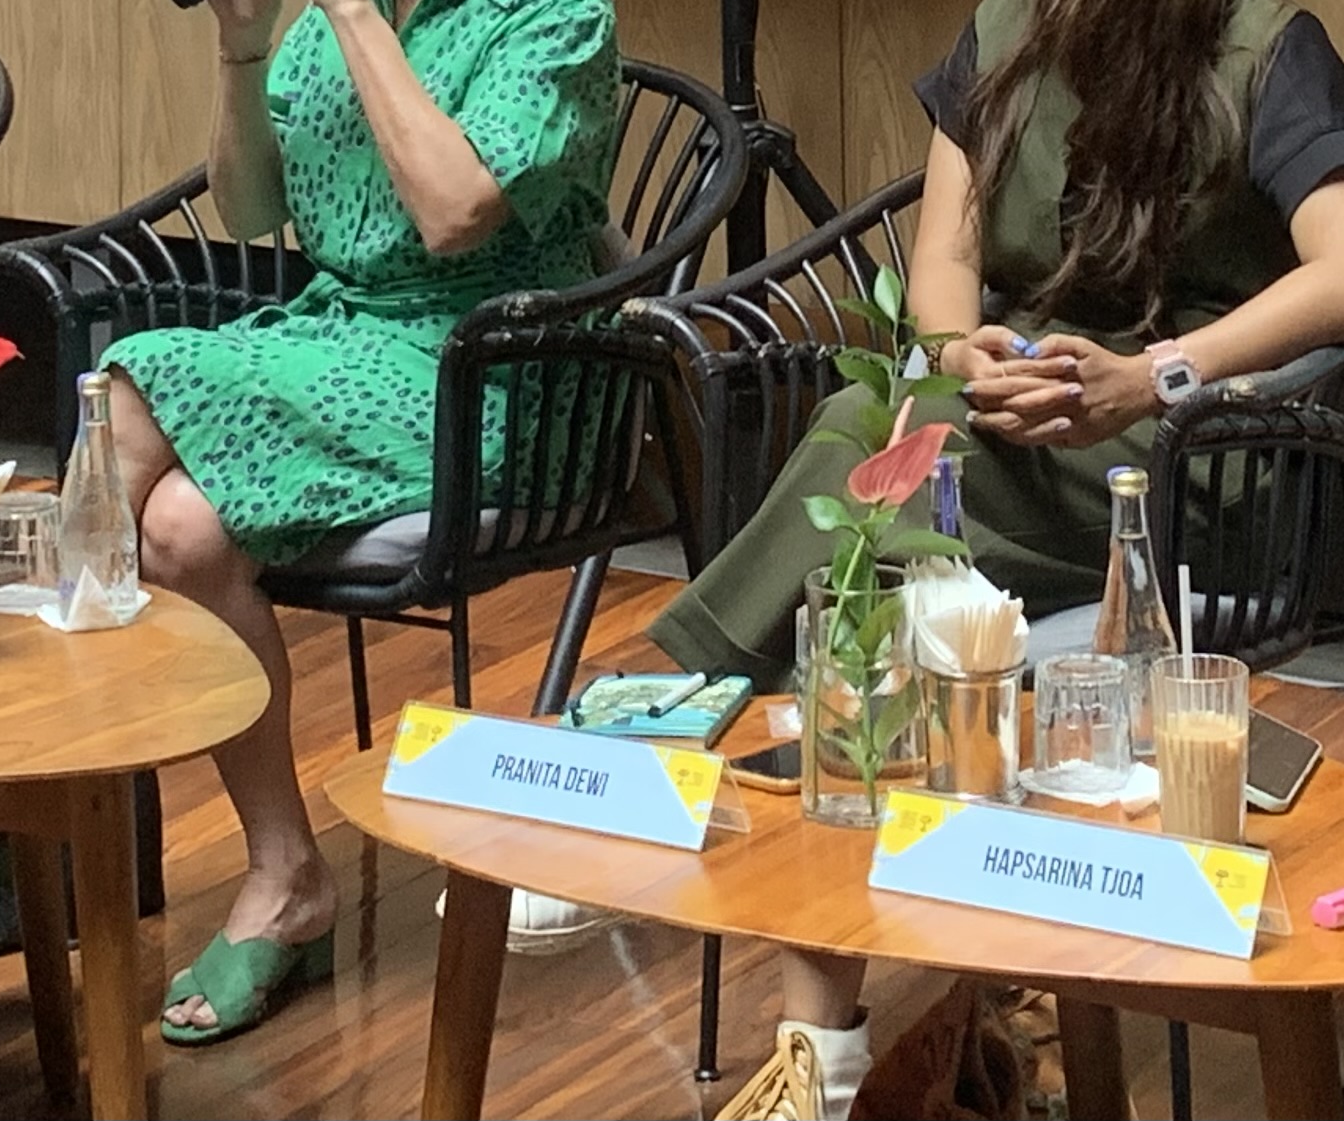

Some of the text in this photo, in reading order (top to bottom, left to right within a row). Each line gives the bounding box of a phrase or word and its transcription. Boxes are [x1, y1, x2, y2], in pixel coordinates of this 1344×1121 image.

[491, 753, 610, 798] PRANITA DEWI
[983, 844, 1145, 901] HAPSARINA TJOA
